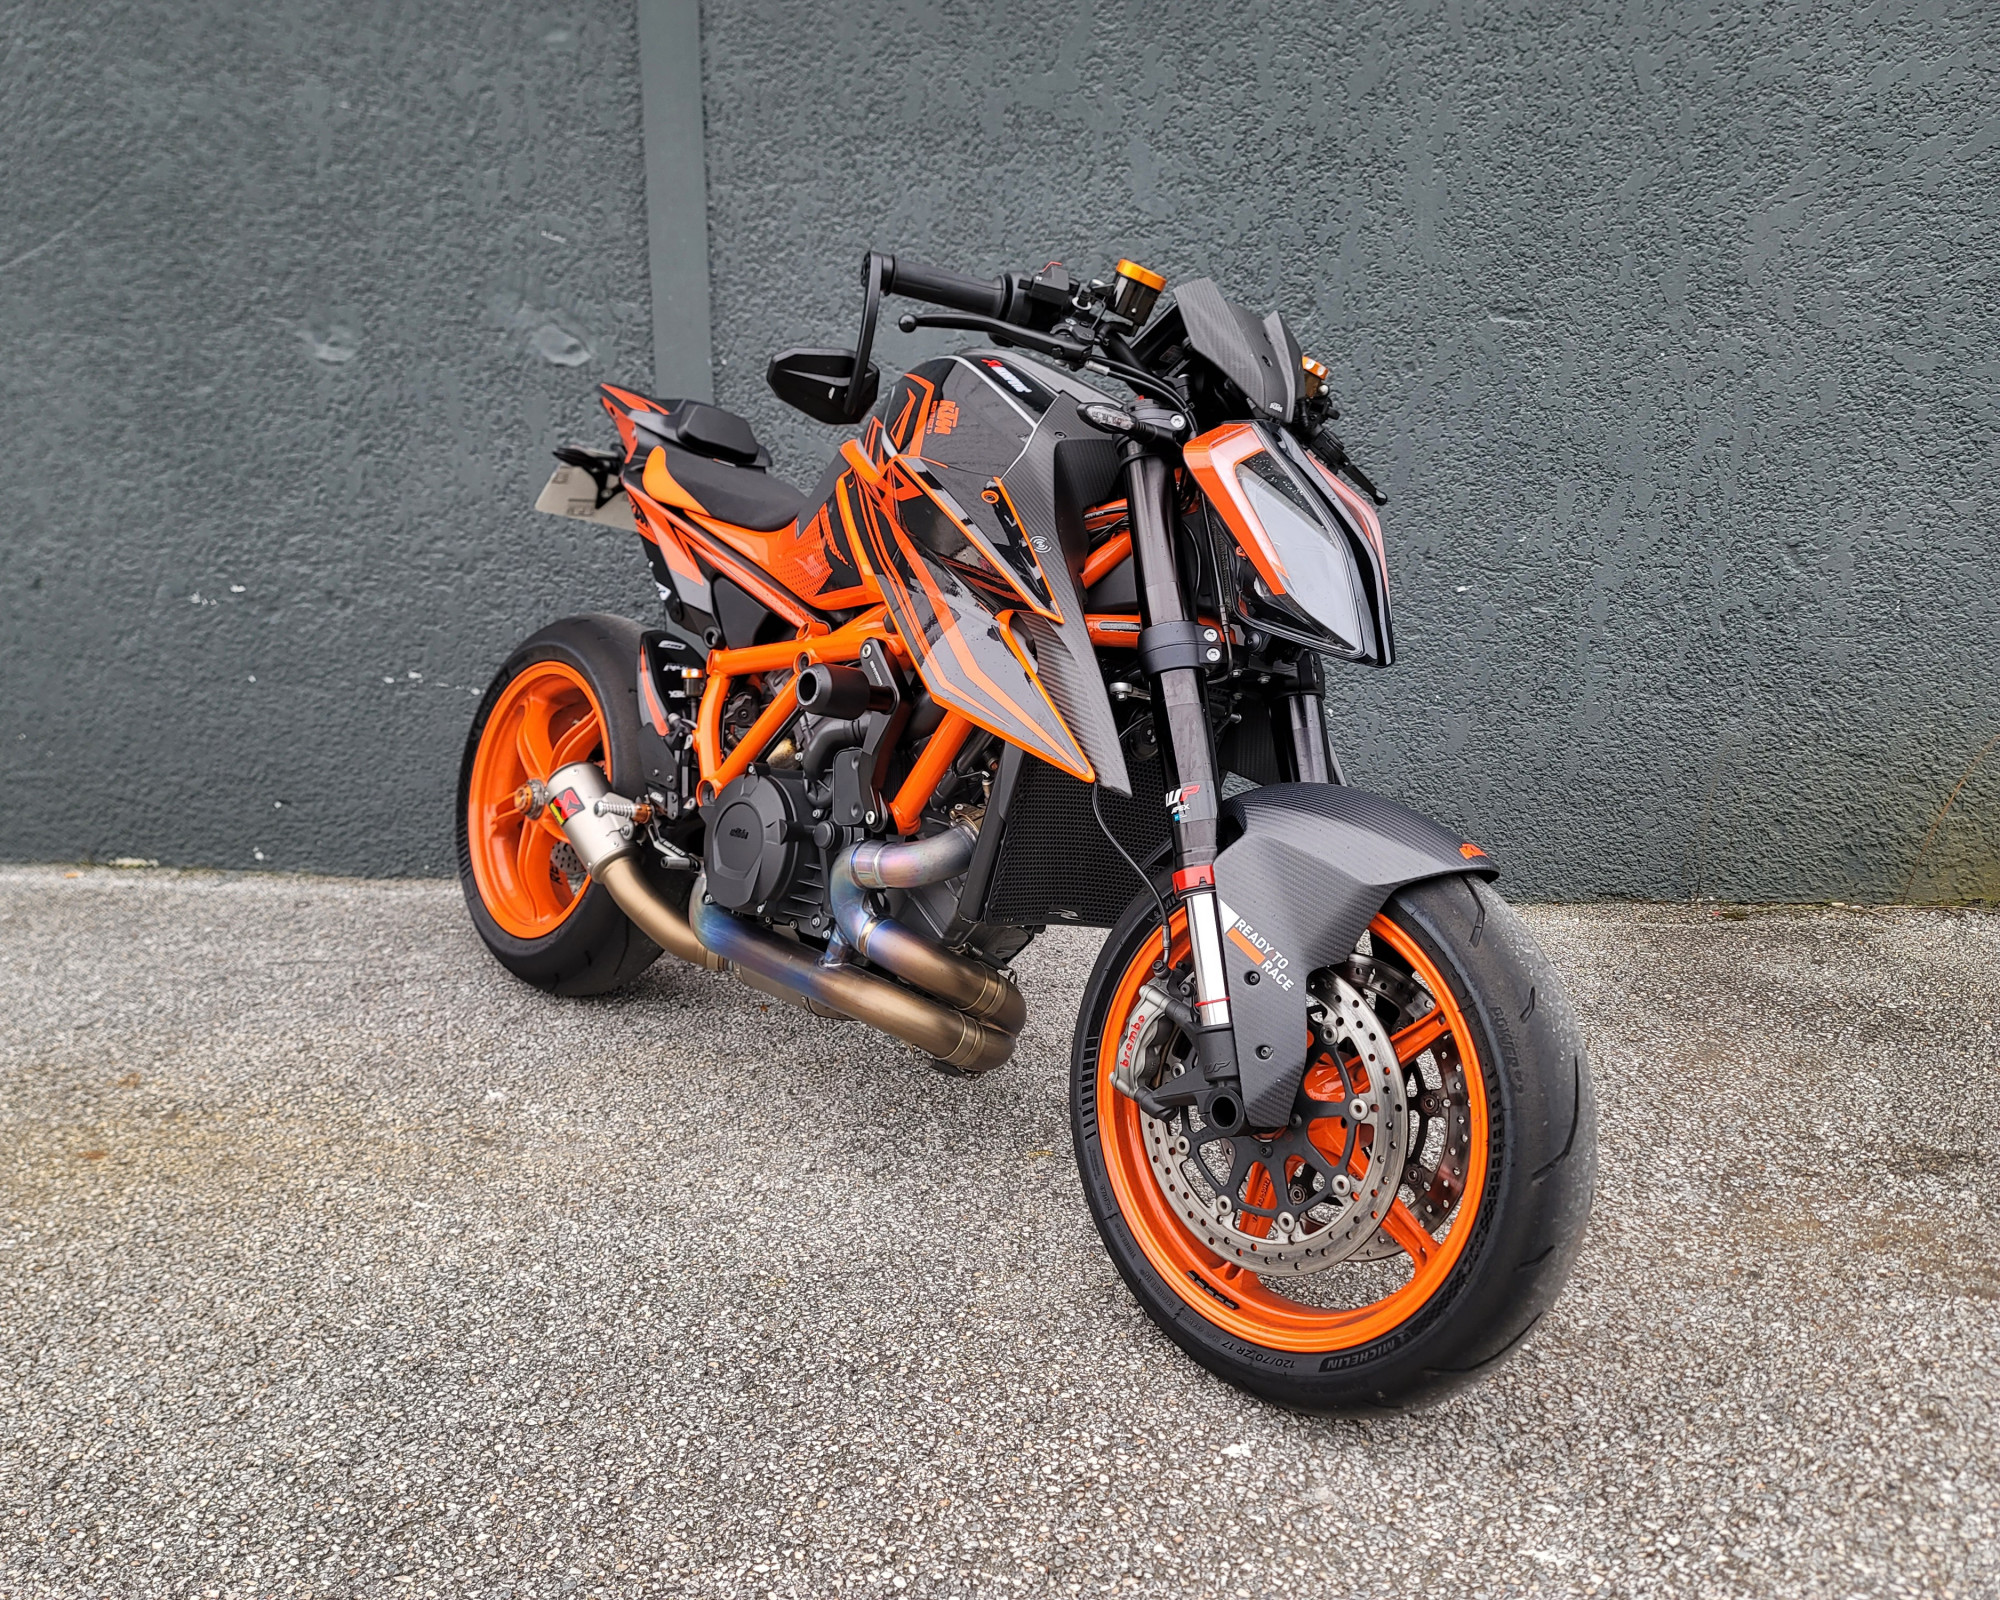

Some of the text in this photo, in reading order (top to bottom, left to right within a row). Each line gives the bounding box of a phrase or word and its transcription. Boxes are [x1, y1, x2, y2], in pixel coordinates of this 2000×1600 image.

[934, 400, 960, 435] KTM
[1165, 784, 1200, 808] WP
[1235, 918, 1289, 970] READY TO
[1261, 960, 1295, 992] RACE
[1120, 1014, 1145, 1068] brembo
[1221, 1340, 1236, 1350] 17
[1236, 1346, 1256, 1358] ZR
[1326, 1339, 1396, 1370] MICHELIN
[1255, 1354, 1296, 1369] 120/70
